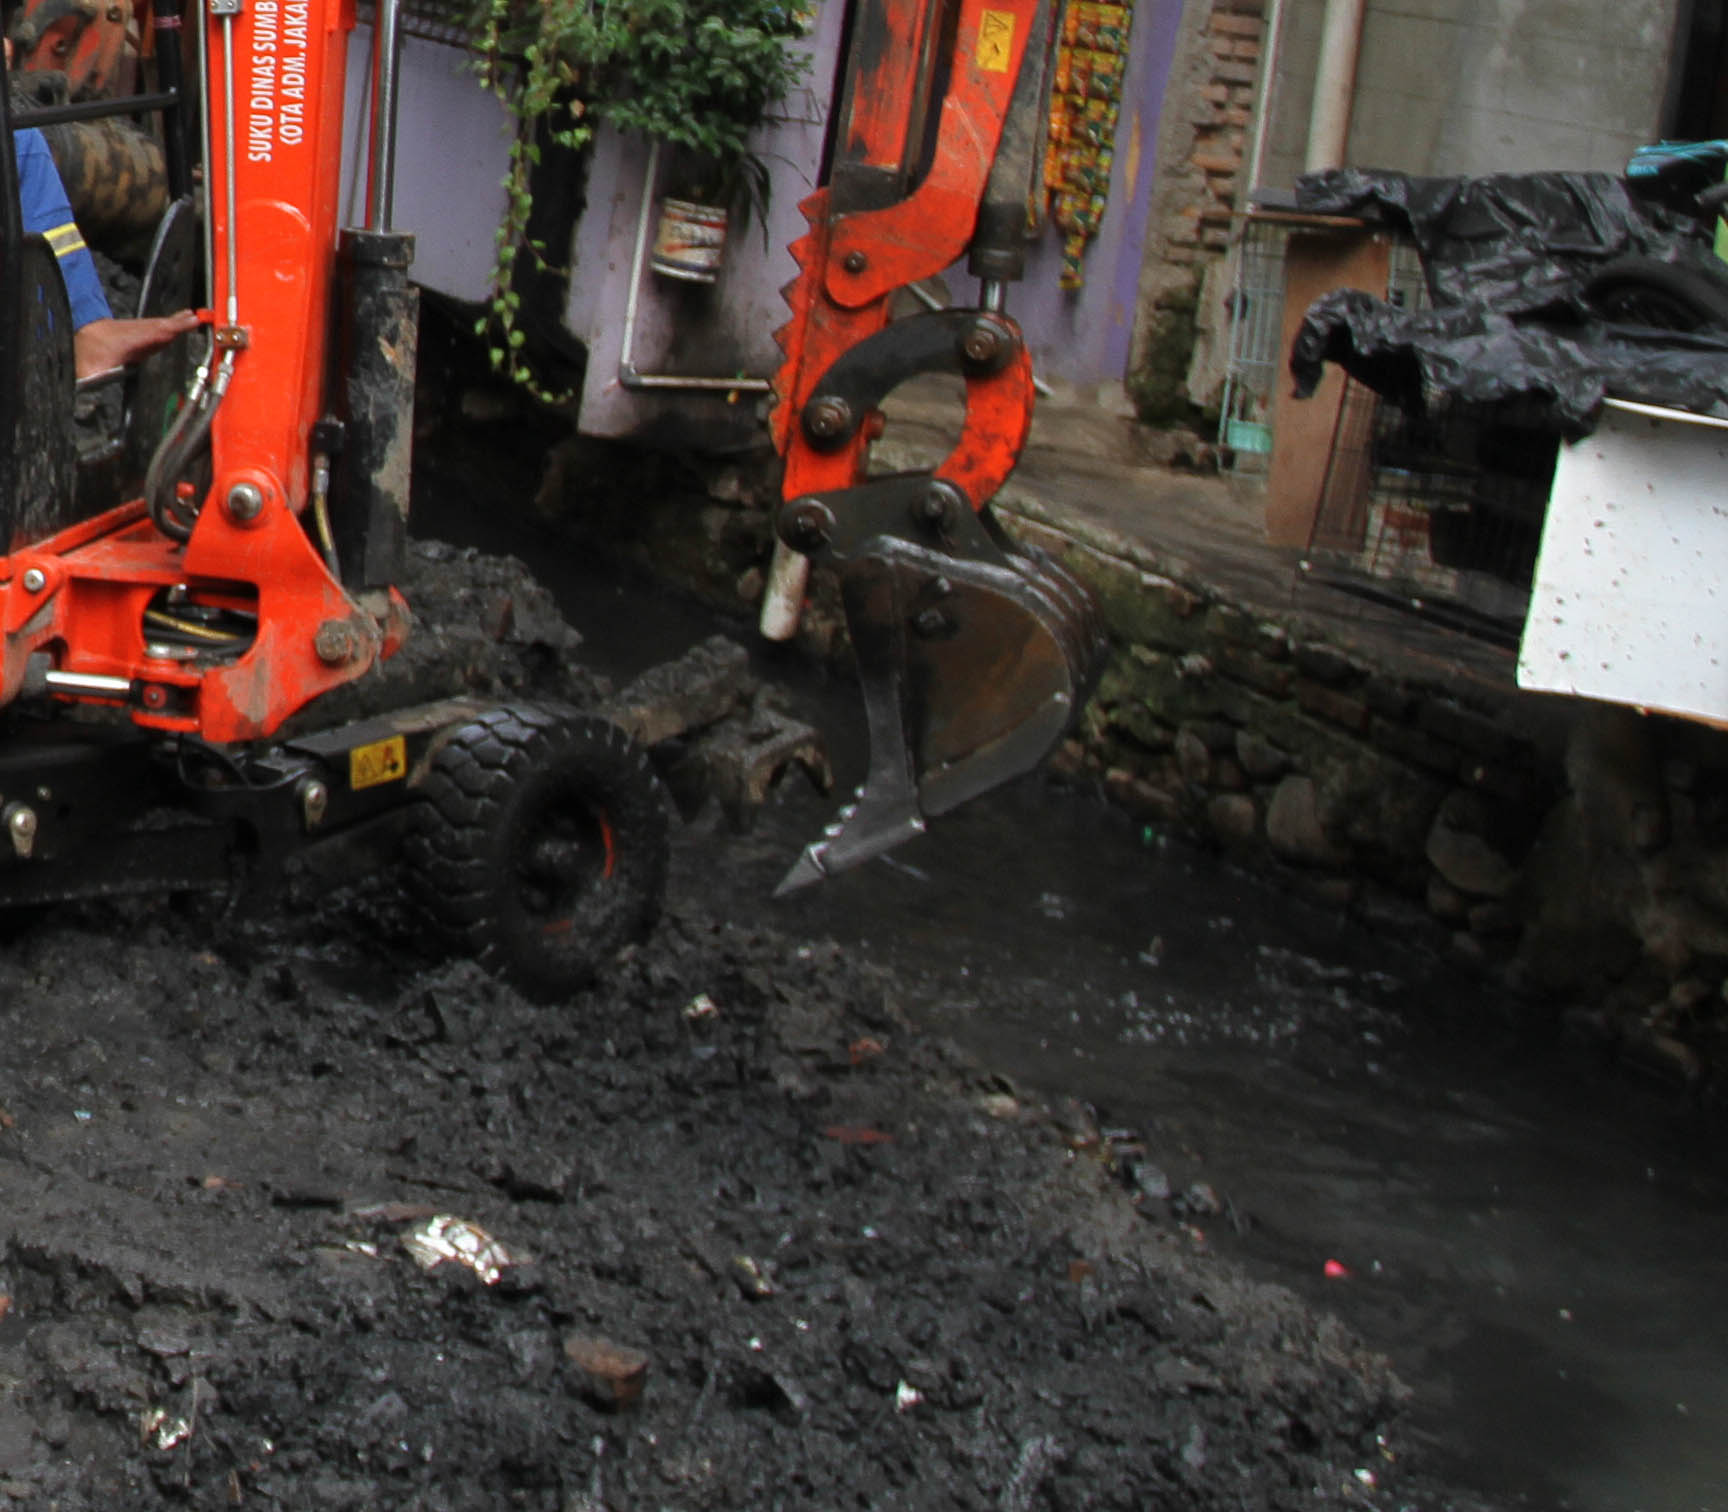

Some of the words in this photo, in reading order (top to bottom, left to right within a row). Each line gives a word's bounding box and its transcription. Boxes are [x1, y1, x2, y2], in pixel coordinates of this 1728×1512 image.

[250, 55, 276, 110] DINAS
[281, 51, 306, 100] ADM.
[248, 114, 274, 163] SUKU
